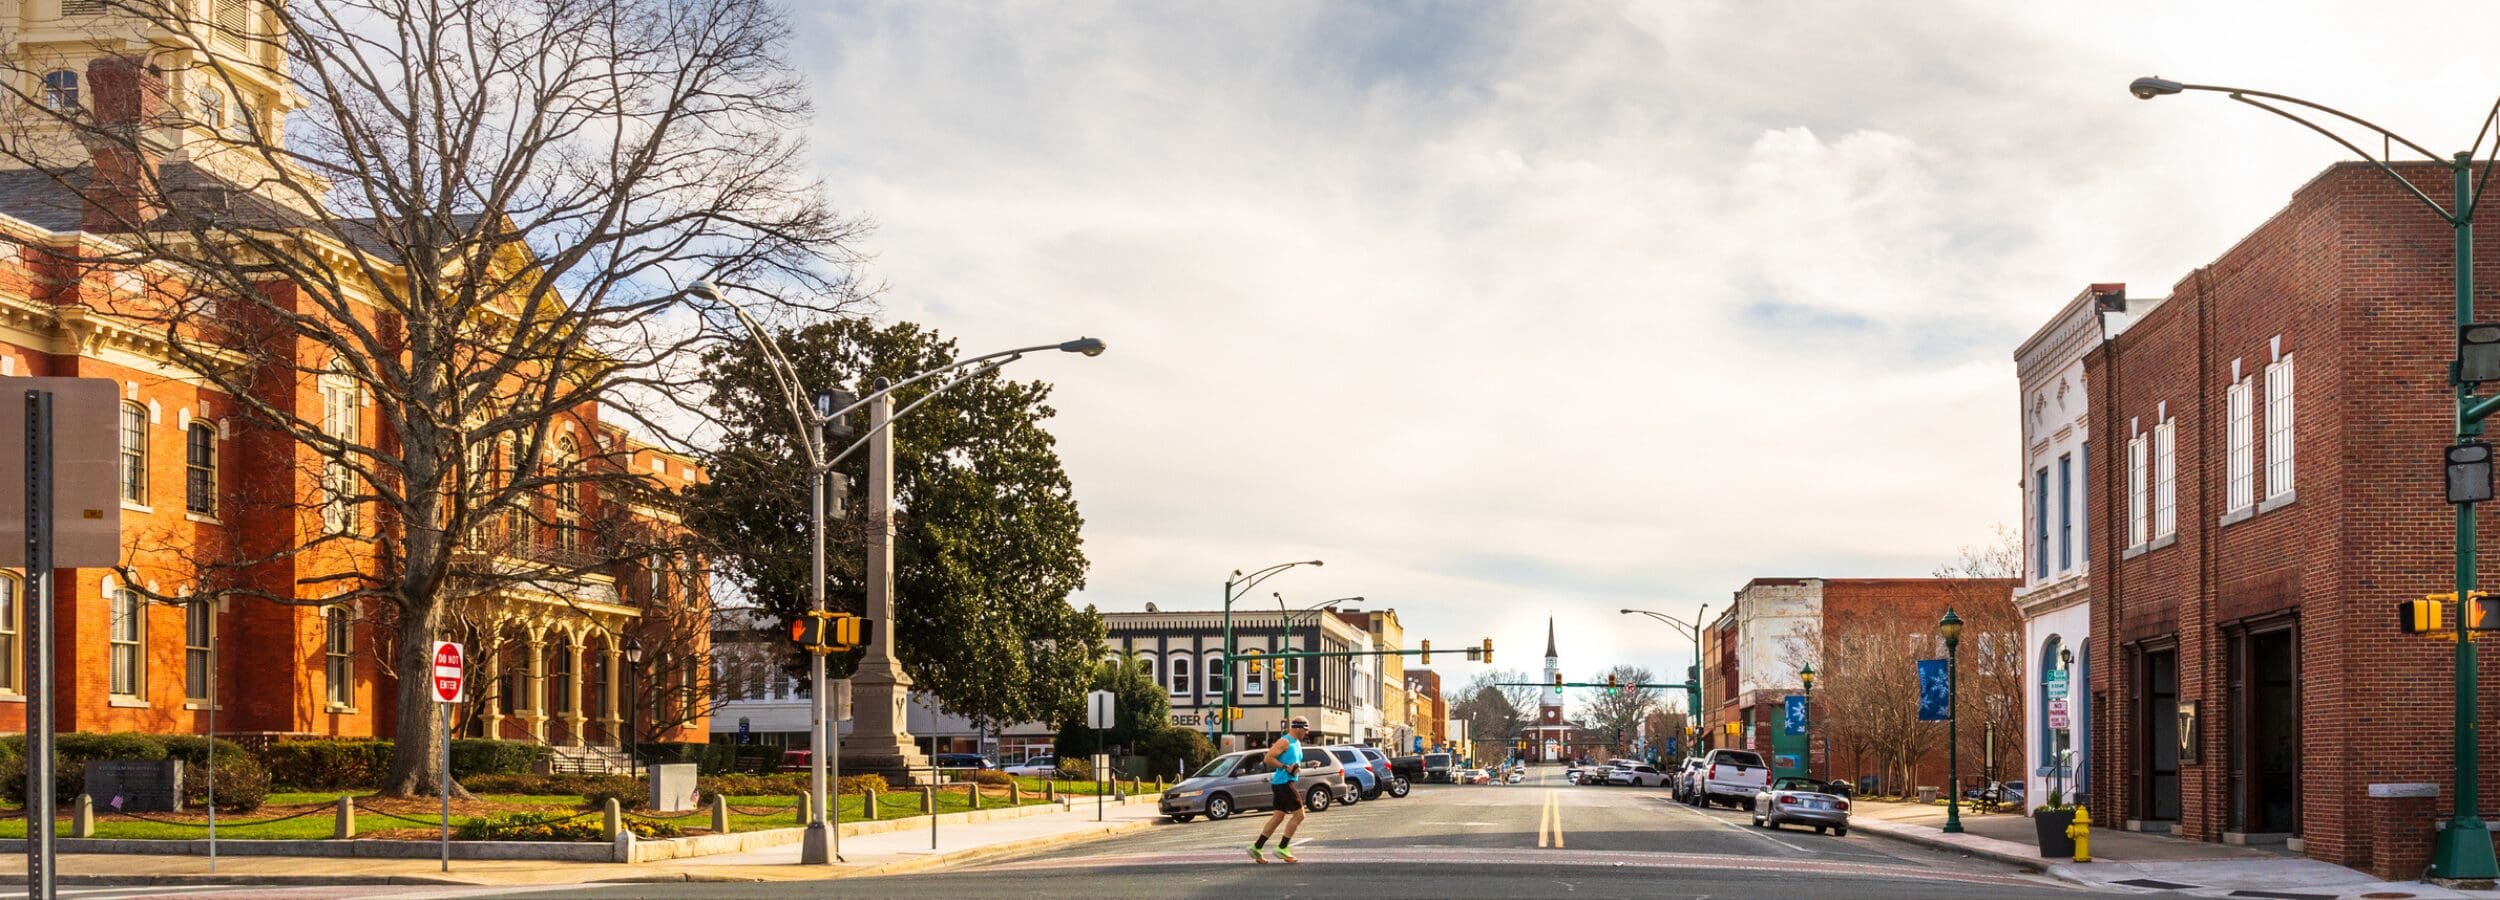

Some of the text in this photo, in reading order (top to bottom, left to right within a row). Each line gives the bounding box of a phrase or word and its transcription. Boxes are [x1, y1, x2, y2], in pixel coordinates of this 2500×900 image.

[438, 654, 459, 665] DO NOT
[440, 680, 457, 690] ENTER
[1171, 714, 1201, 726] BEER
